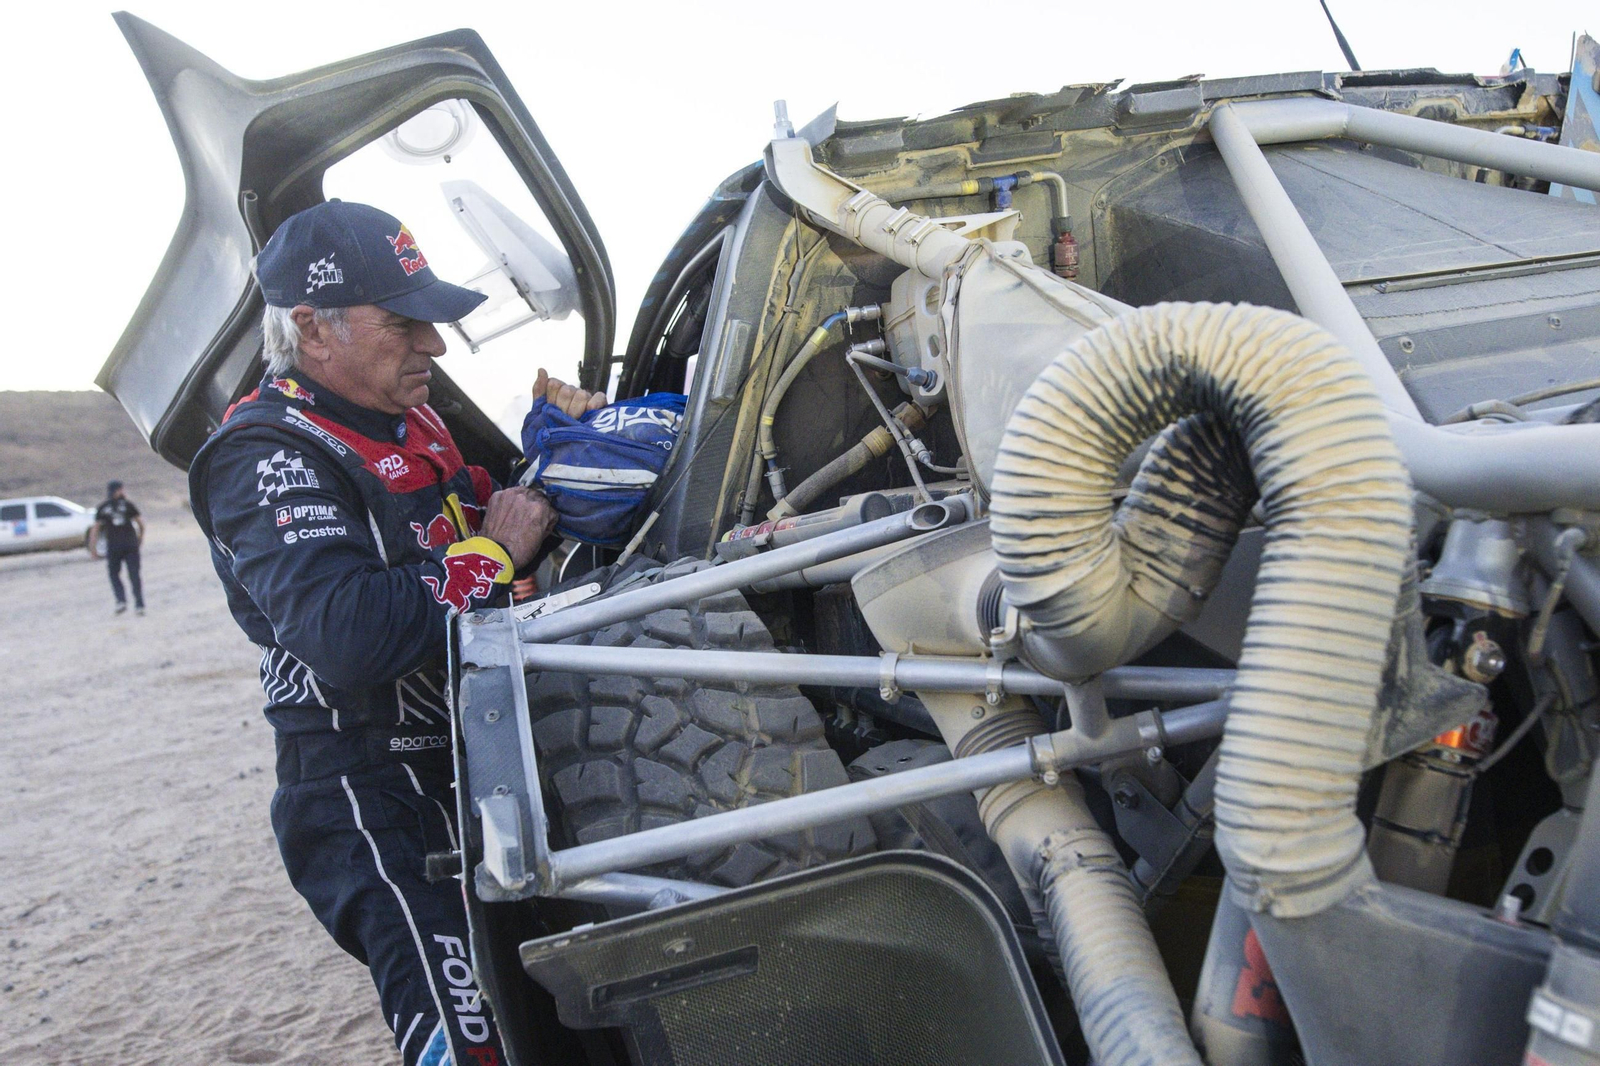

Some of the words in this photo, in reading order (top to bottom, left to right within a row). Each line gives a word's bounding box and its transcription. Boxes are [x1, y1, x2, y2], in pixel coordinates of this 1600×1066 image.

[282, 415, 347, 457] sparco
[298, 525, 347, 539] Castrol
[389, 735, 448, 752] sparco
[433, 934, 490, 1043] FORD
